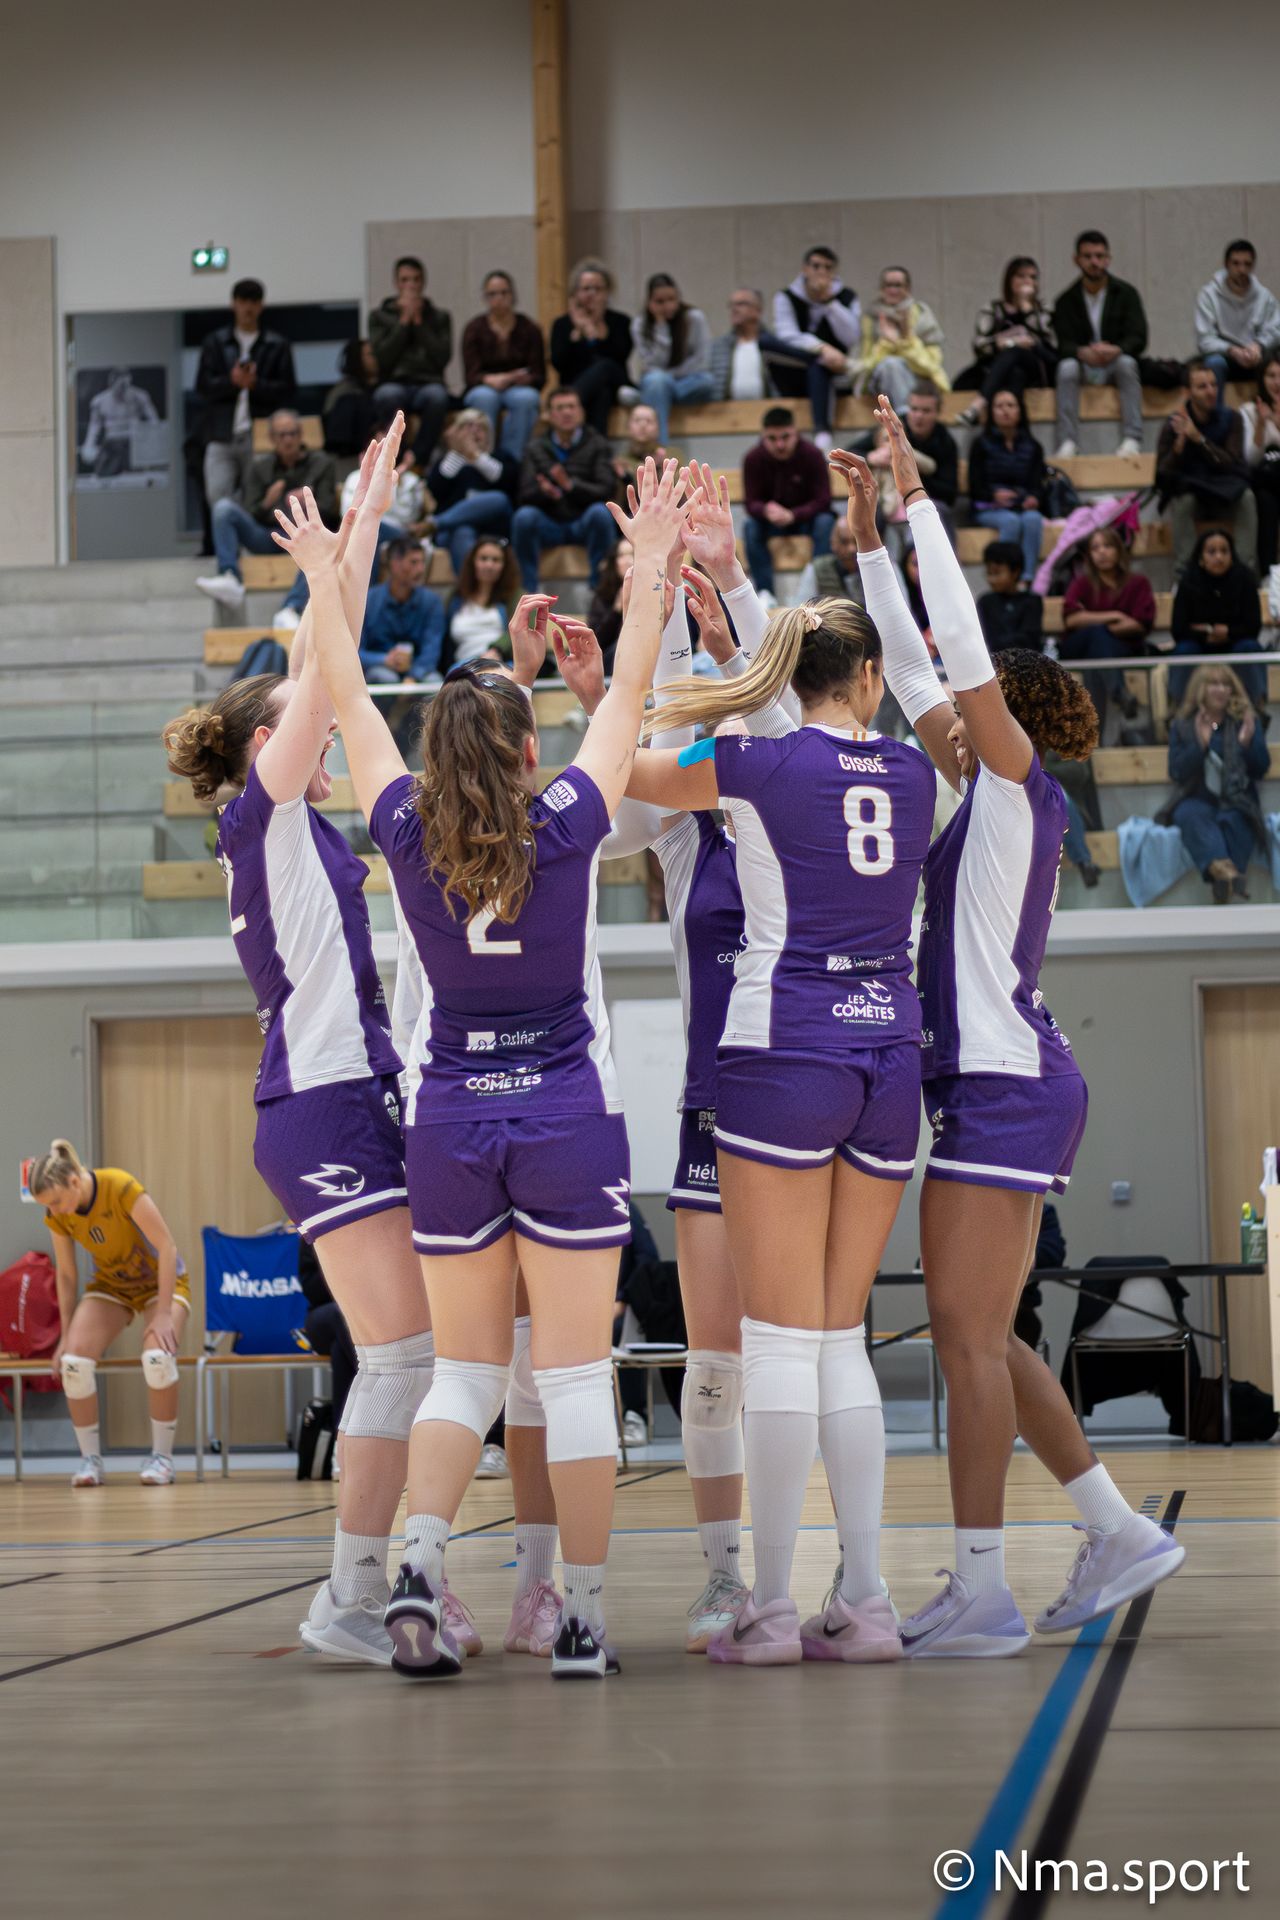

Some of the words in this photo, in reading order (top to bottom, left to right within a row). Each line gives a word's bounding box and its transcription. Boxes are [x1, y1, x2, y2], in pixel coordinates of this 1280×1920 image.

[838, 753, 888, 774] CISSÉ
[551, 782, 575, 807] KING
[843, 785, 894, 876] 8
[467, 877, 522, 954] 2
[847, 994, 865, 1004] LES
[832, 1001, 896, 1020] COMÈTES
[465, 1073, 542, 1091] COMÈTES
[88, 1225, 105, 1244] 10
